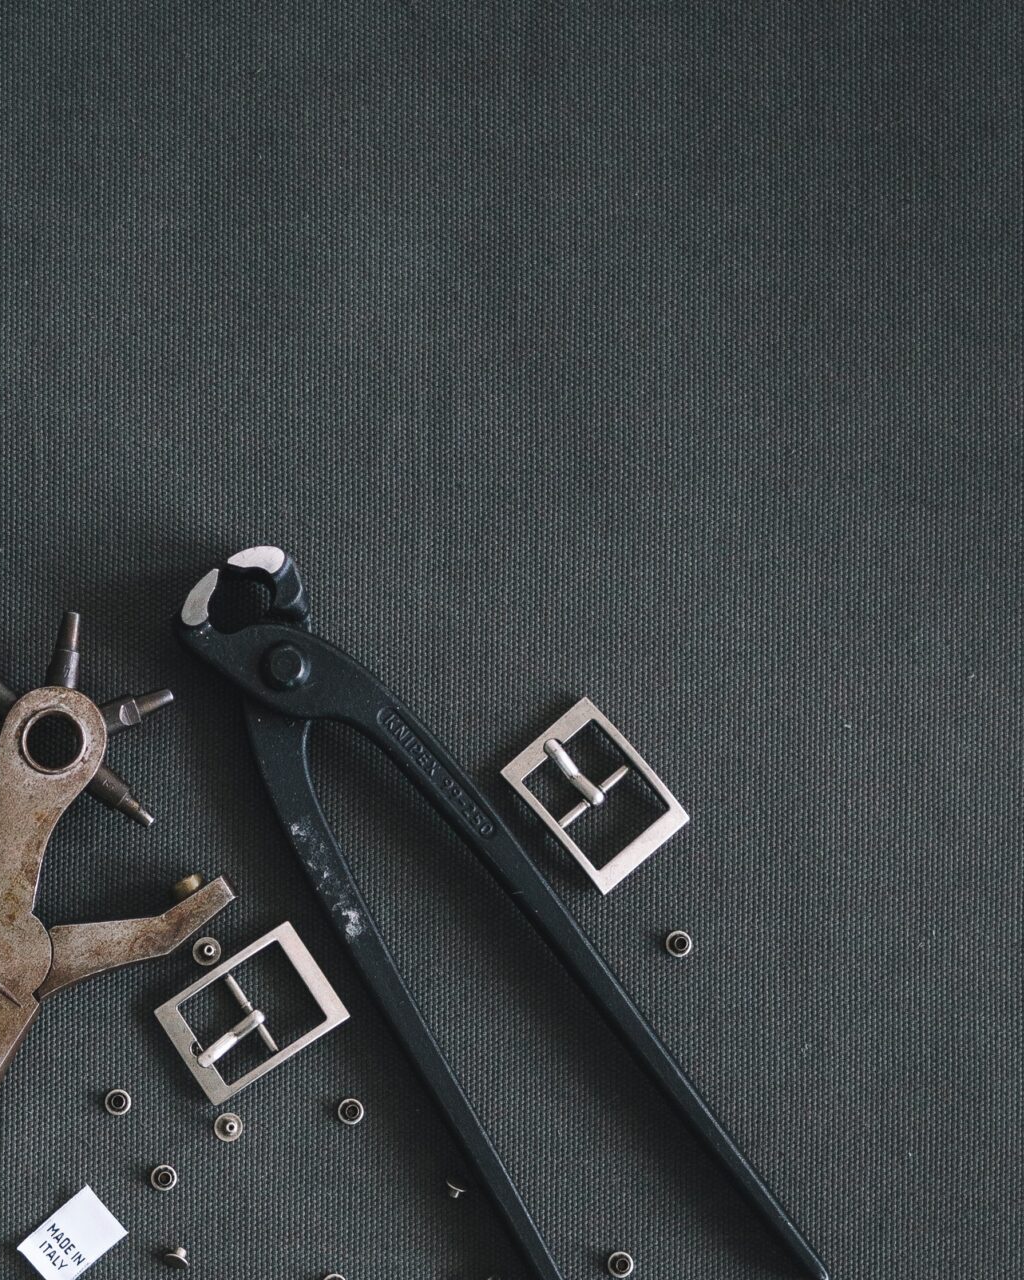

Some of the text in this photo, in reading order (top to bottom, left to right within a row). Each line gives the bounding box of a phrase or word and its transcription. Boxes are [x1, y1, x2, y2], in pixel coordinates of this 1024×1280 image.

[384, 714, 438, 777] KNIPEX
[39, 1240, 68, 1270] ITALY
[46, 1222, 86, 1266] MADE IN
